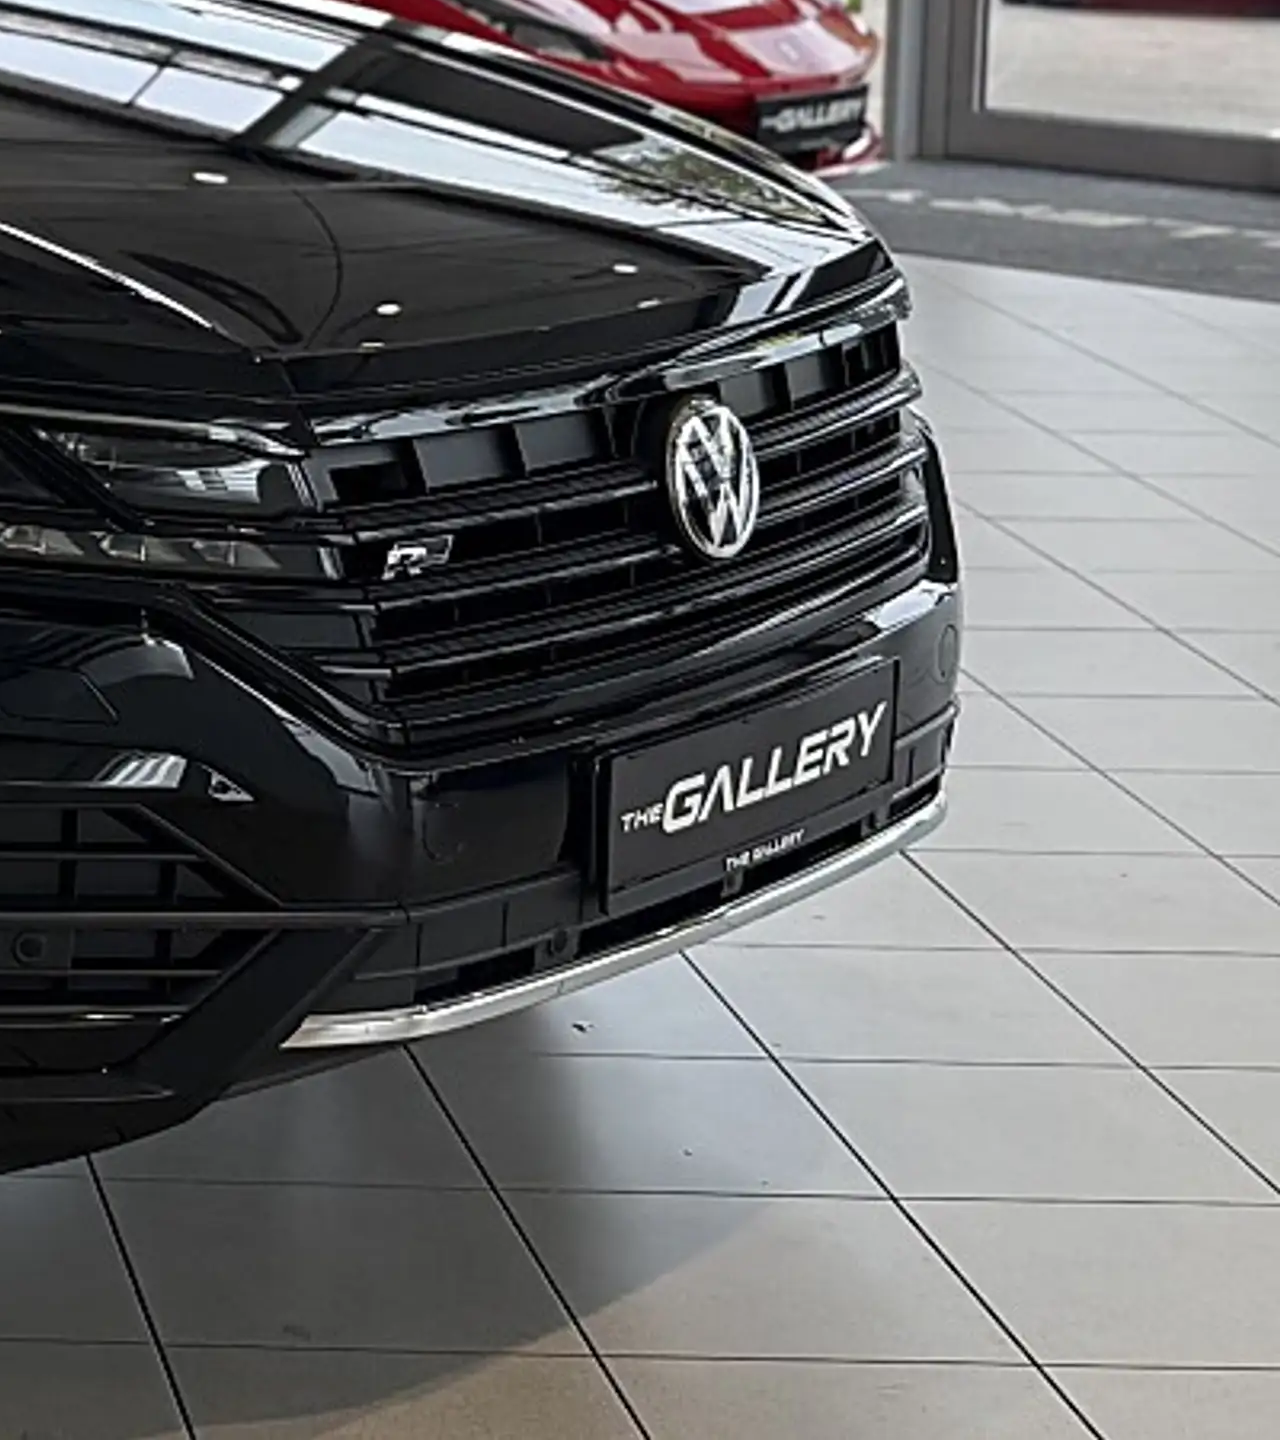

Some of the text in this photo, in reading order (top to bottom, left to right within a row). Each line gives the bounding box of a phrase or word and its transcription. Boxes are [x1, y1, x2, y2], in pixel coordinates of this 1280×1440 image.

[621, 700, 888, 834] THE GALLERY
[726, 850, 750, 872] THE
